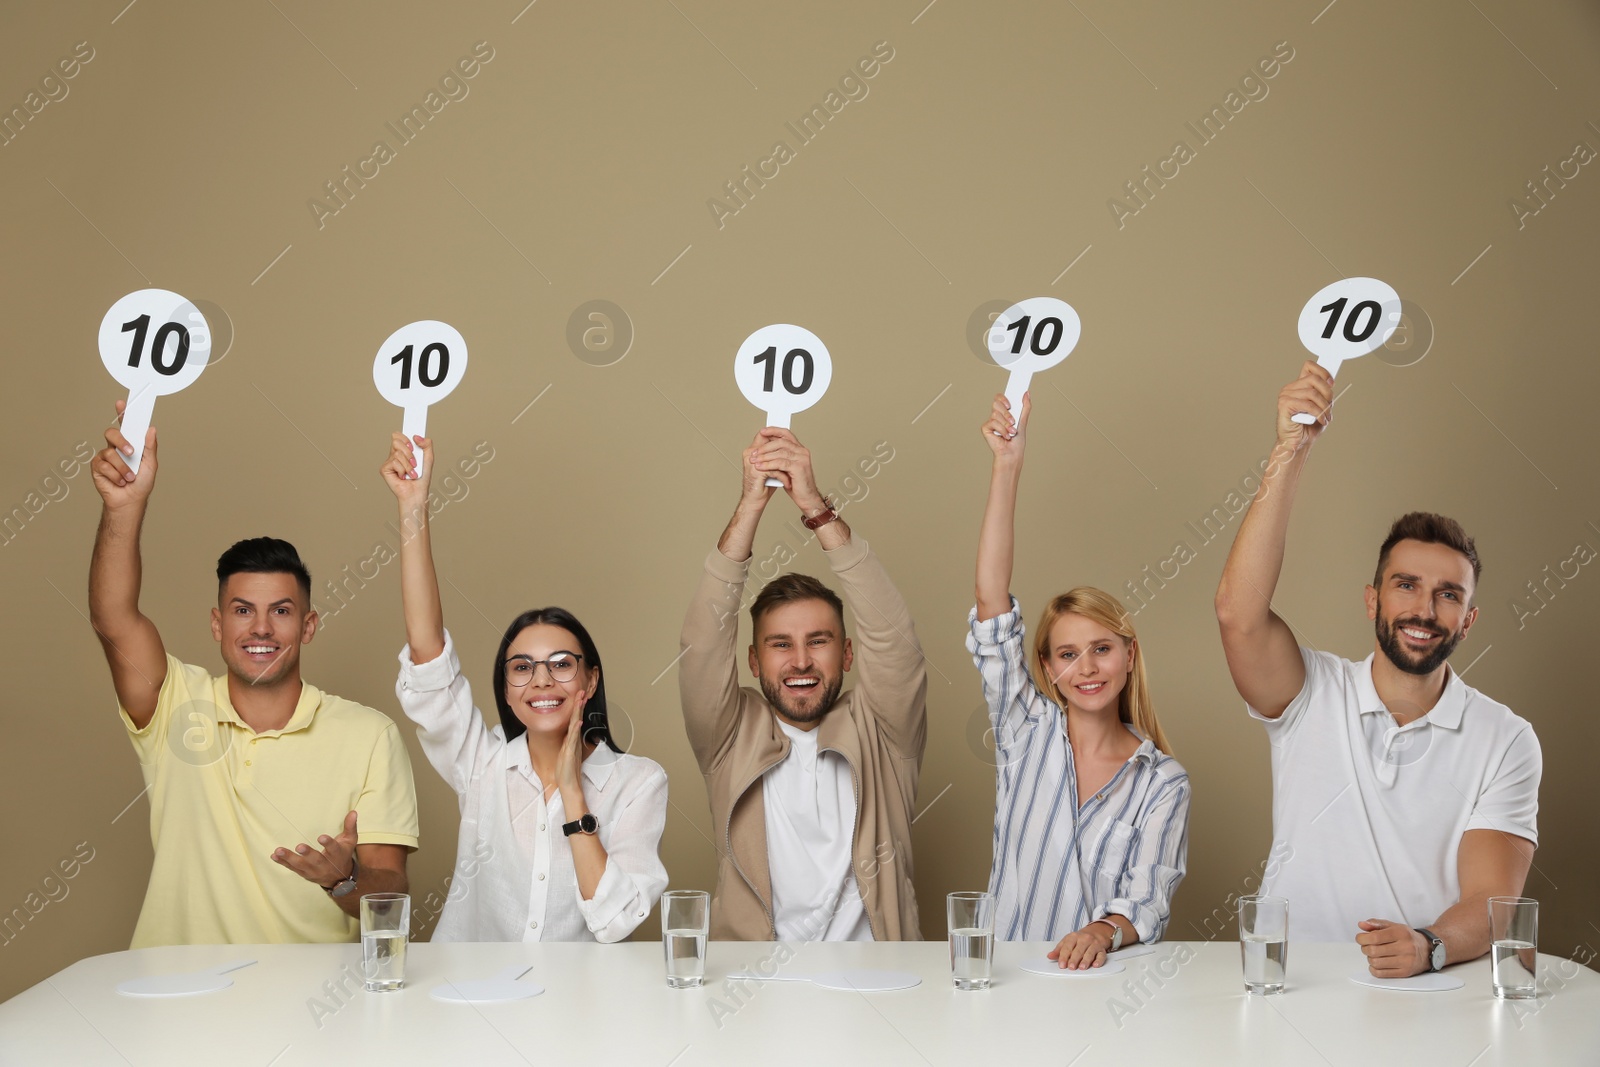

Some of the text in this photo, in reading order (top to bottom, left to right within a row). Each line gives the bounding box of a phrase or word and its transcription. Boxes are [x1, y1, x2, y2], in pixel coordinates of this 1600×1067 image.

[1006, 315, 1064, 356] 10
[1320, 297, 1382, 343] 10
[121, 314, 190, 376] 10
[391, 342, 450, 388] 10
[753, 346, 814, 395] 10
